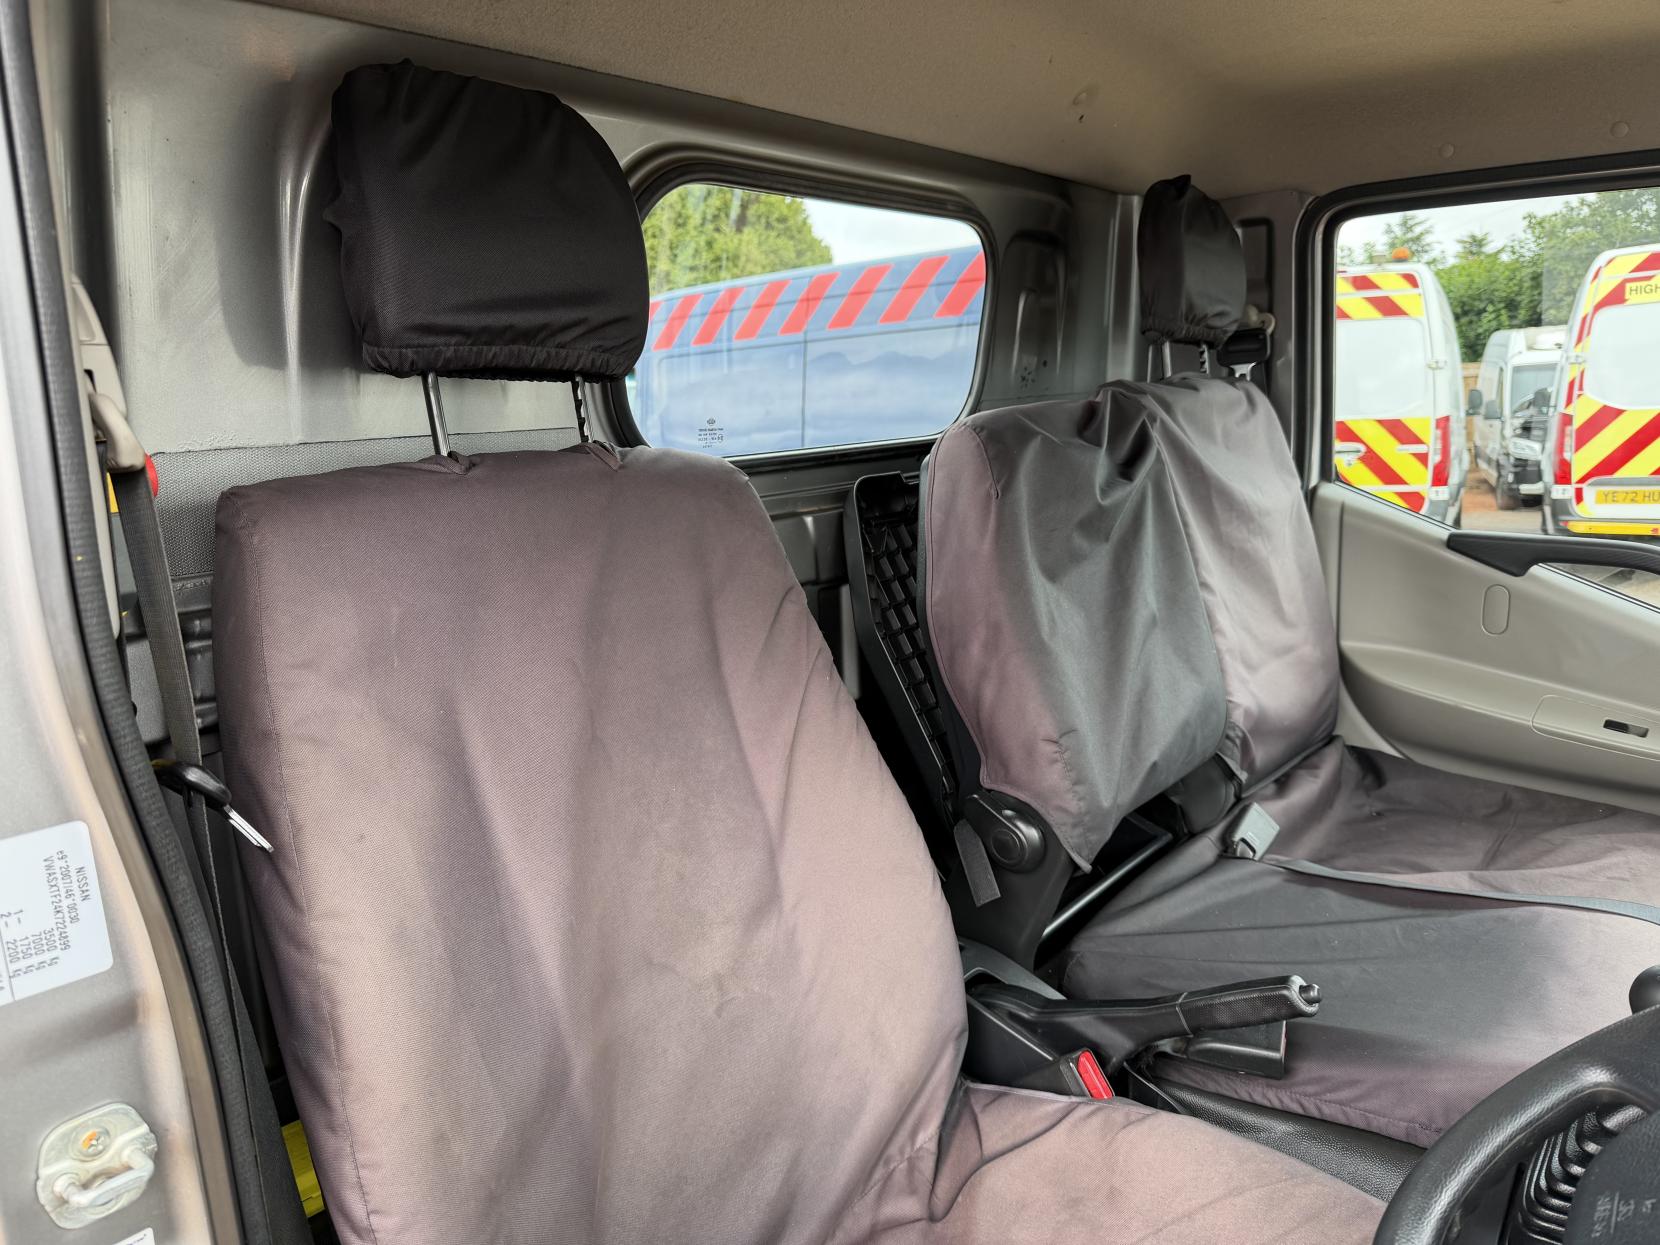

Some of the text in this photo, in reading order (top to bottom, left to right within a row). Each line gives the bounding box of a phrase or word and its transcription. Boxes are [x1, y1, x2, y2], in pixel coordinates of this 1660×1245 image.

[1603, 491, 1638, 503] YE72
[75, 866, 91, 901] NISSAN
[6, 939, 20, 963] 2200
[19, 936, 33, 959] 1750
[31, 932, 45, 955] 7000
[43, 928, 57, 951] 3500
